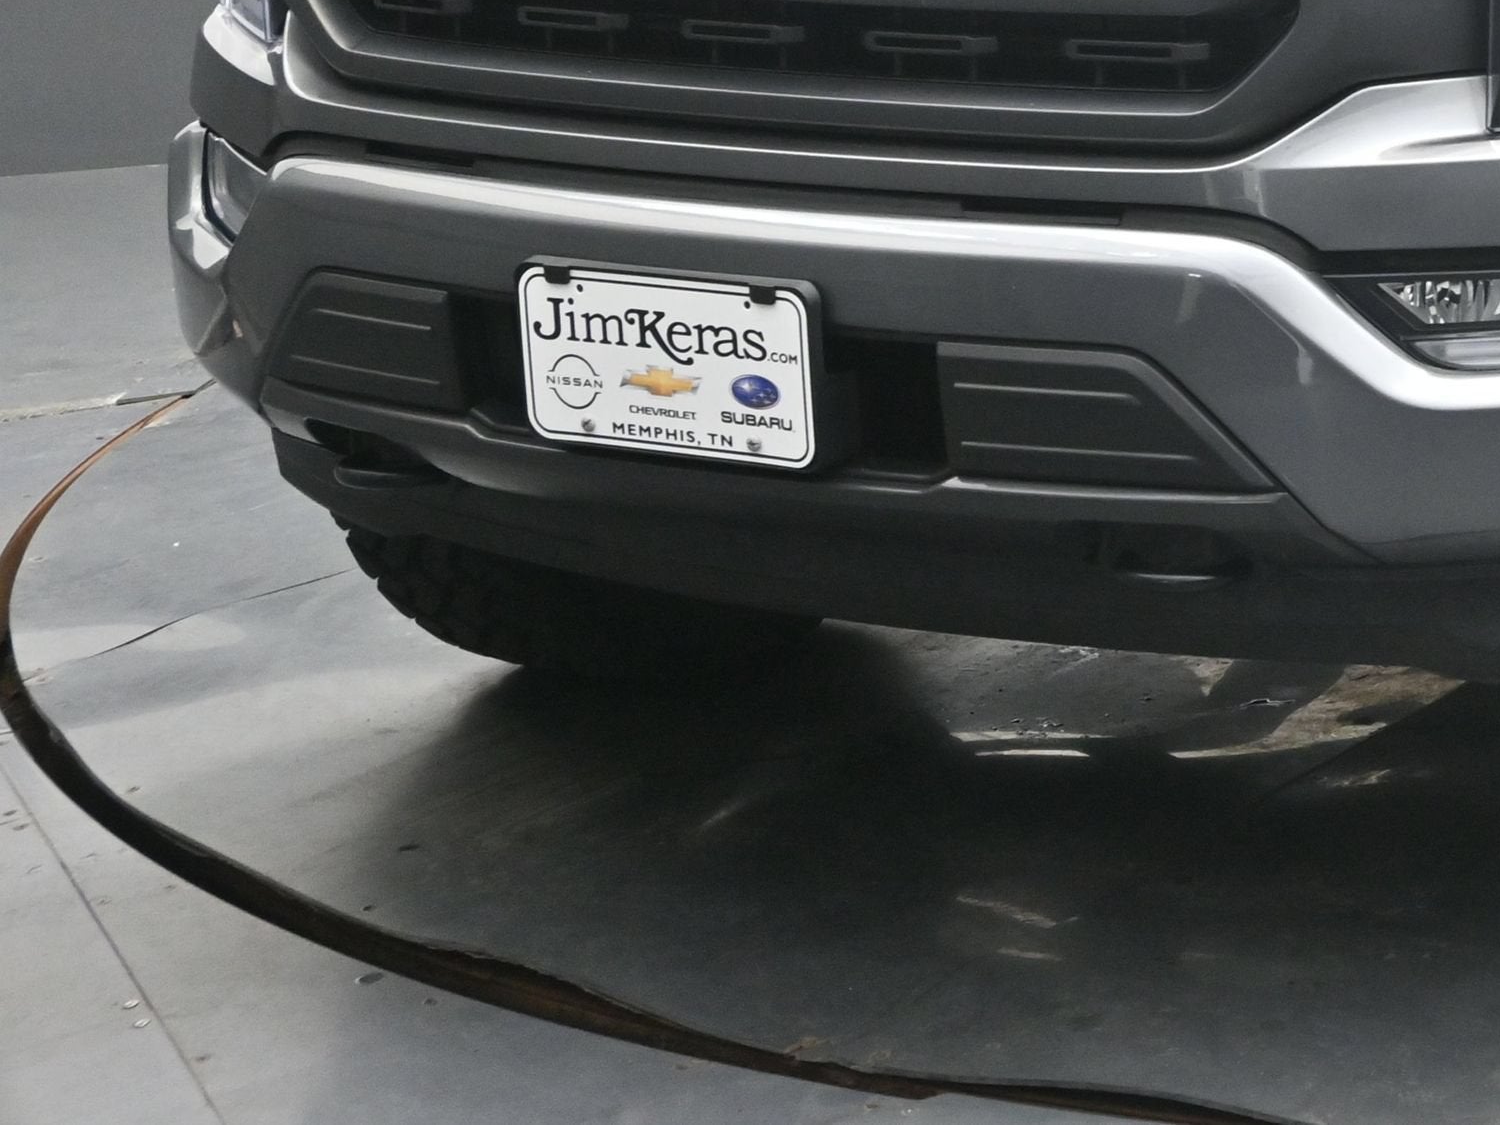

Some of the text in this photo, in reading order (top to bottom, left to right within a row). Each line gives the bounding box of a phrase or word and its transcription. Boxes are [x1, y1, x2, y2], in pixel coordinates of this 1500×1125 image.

[546, 374, 603, 389] NISSAN
[628, 404, 697, 421] CHEVROLET
[720, 411, 793, 432] SUBARU
[612, 421, 734, 448] MEMPHIS, TN
